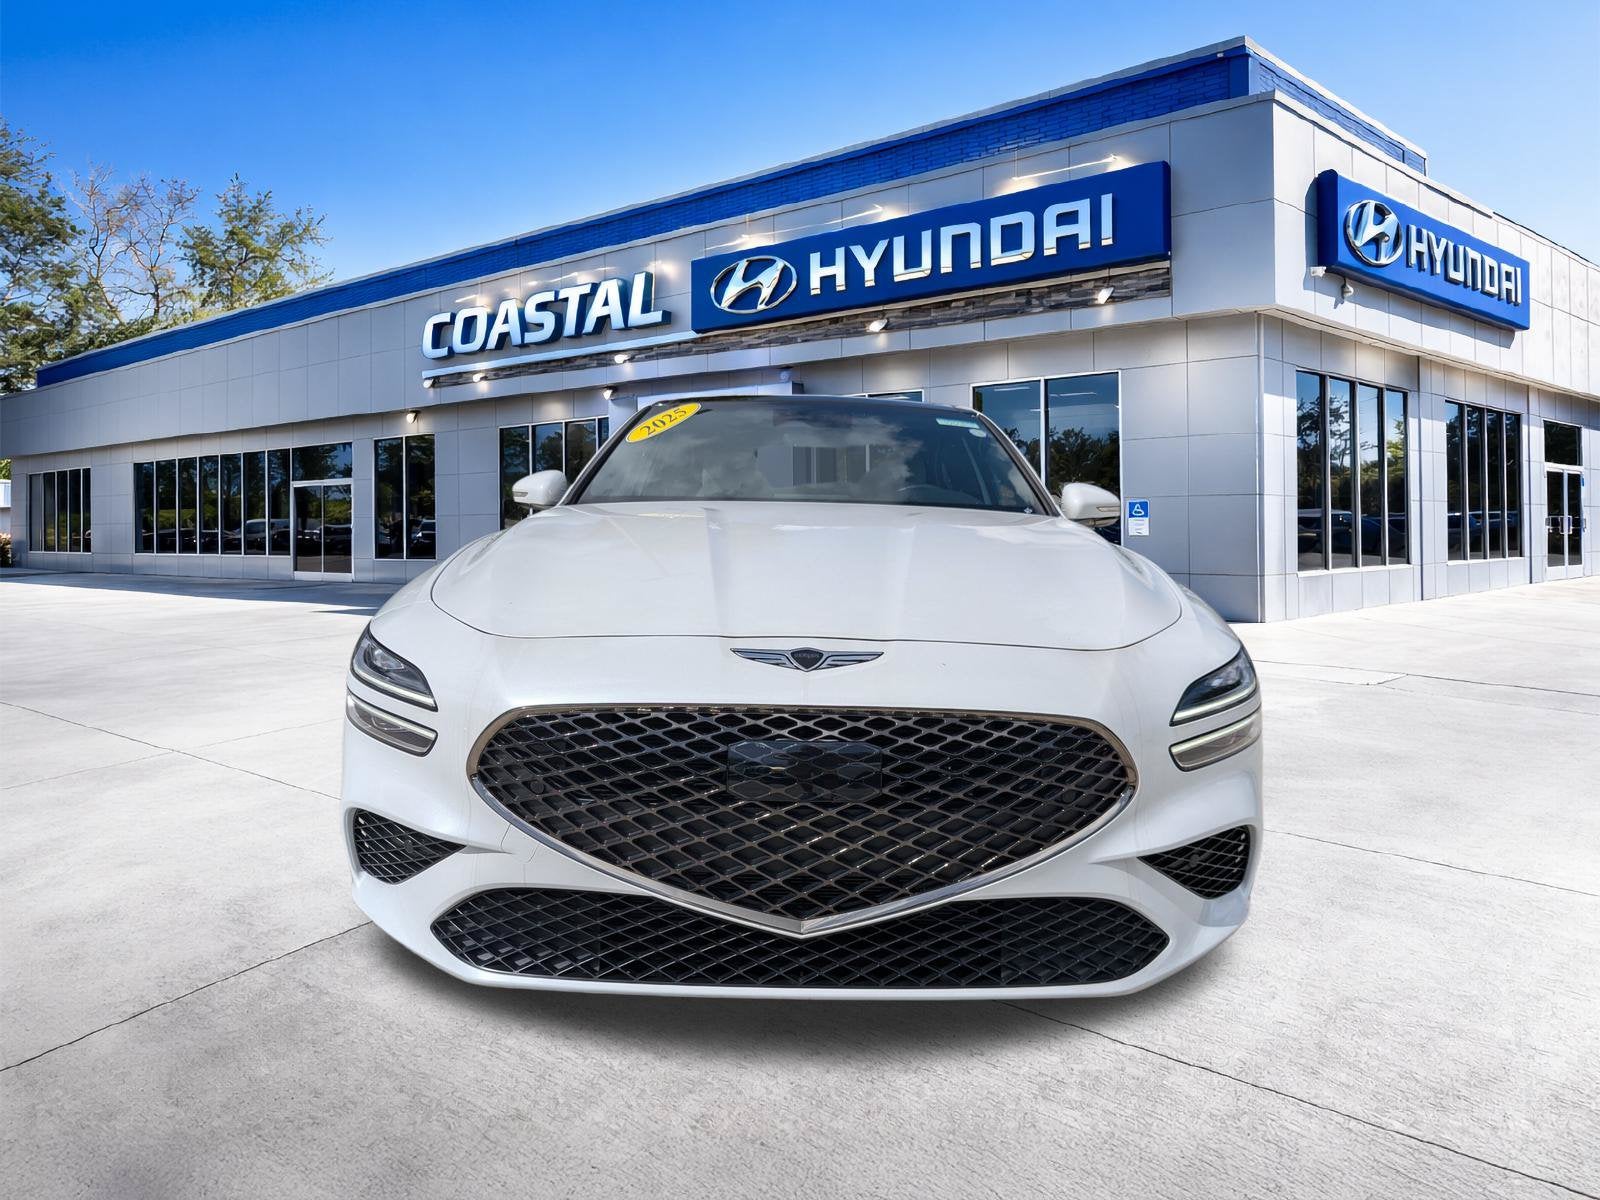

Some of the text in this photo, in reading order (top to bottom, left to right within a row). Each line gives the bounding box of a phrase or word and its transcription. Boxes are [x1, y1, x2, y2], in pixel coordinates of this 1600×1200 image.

[809, 193, 1113, 295] HYUNDAI
[1407, 225, 1522, 305] HYUNDAI
[421, 271, 667, 360] COASTAL
[640, 409, 687, 435] 2025
